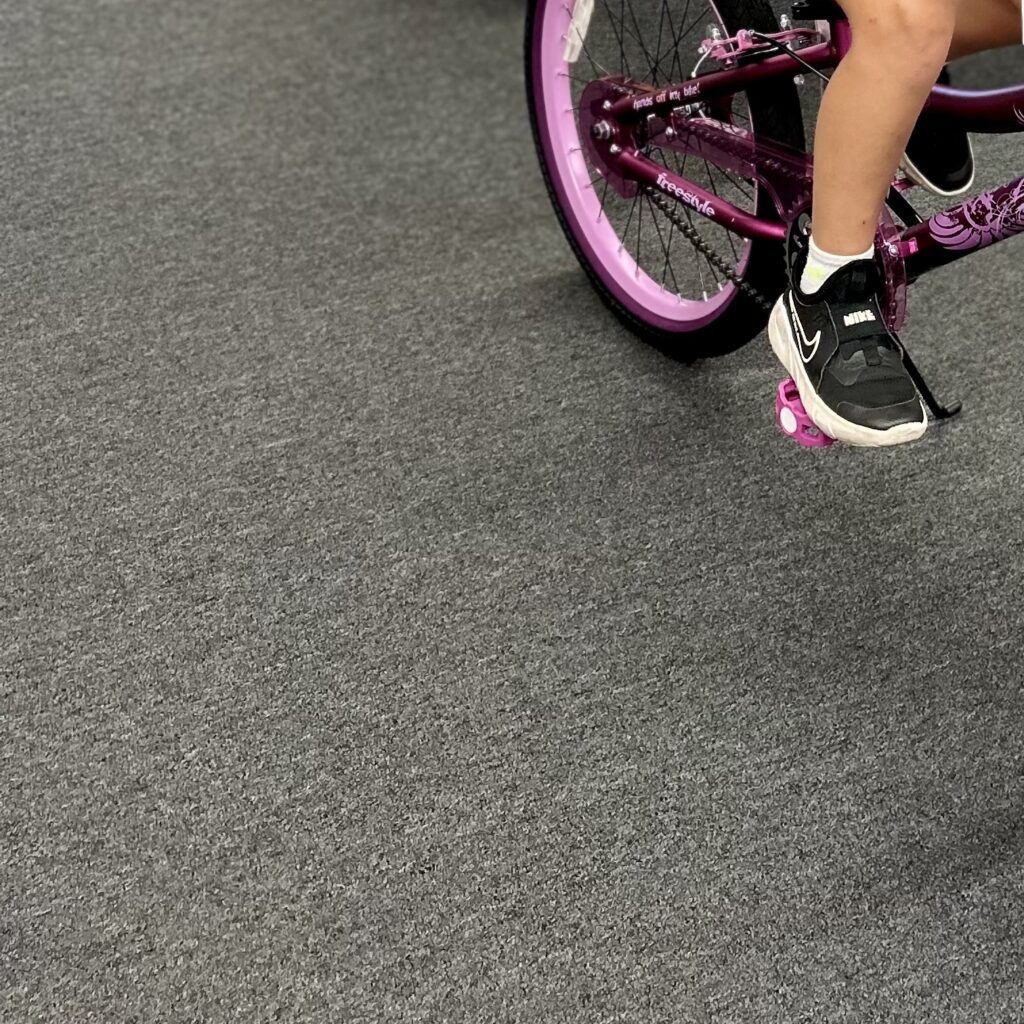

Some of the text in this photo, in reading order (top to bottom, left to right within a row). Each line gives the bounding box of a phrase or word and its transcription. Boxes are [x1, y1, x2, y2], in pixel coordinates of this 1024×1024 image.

[655, 90, 667, 103] off
[656, 172, 715, 217] freestyle
[843, 309, 876, 327] NIKE
